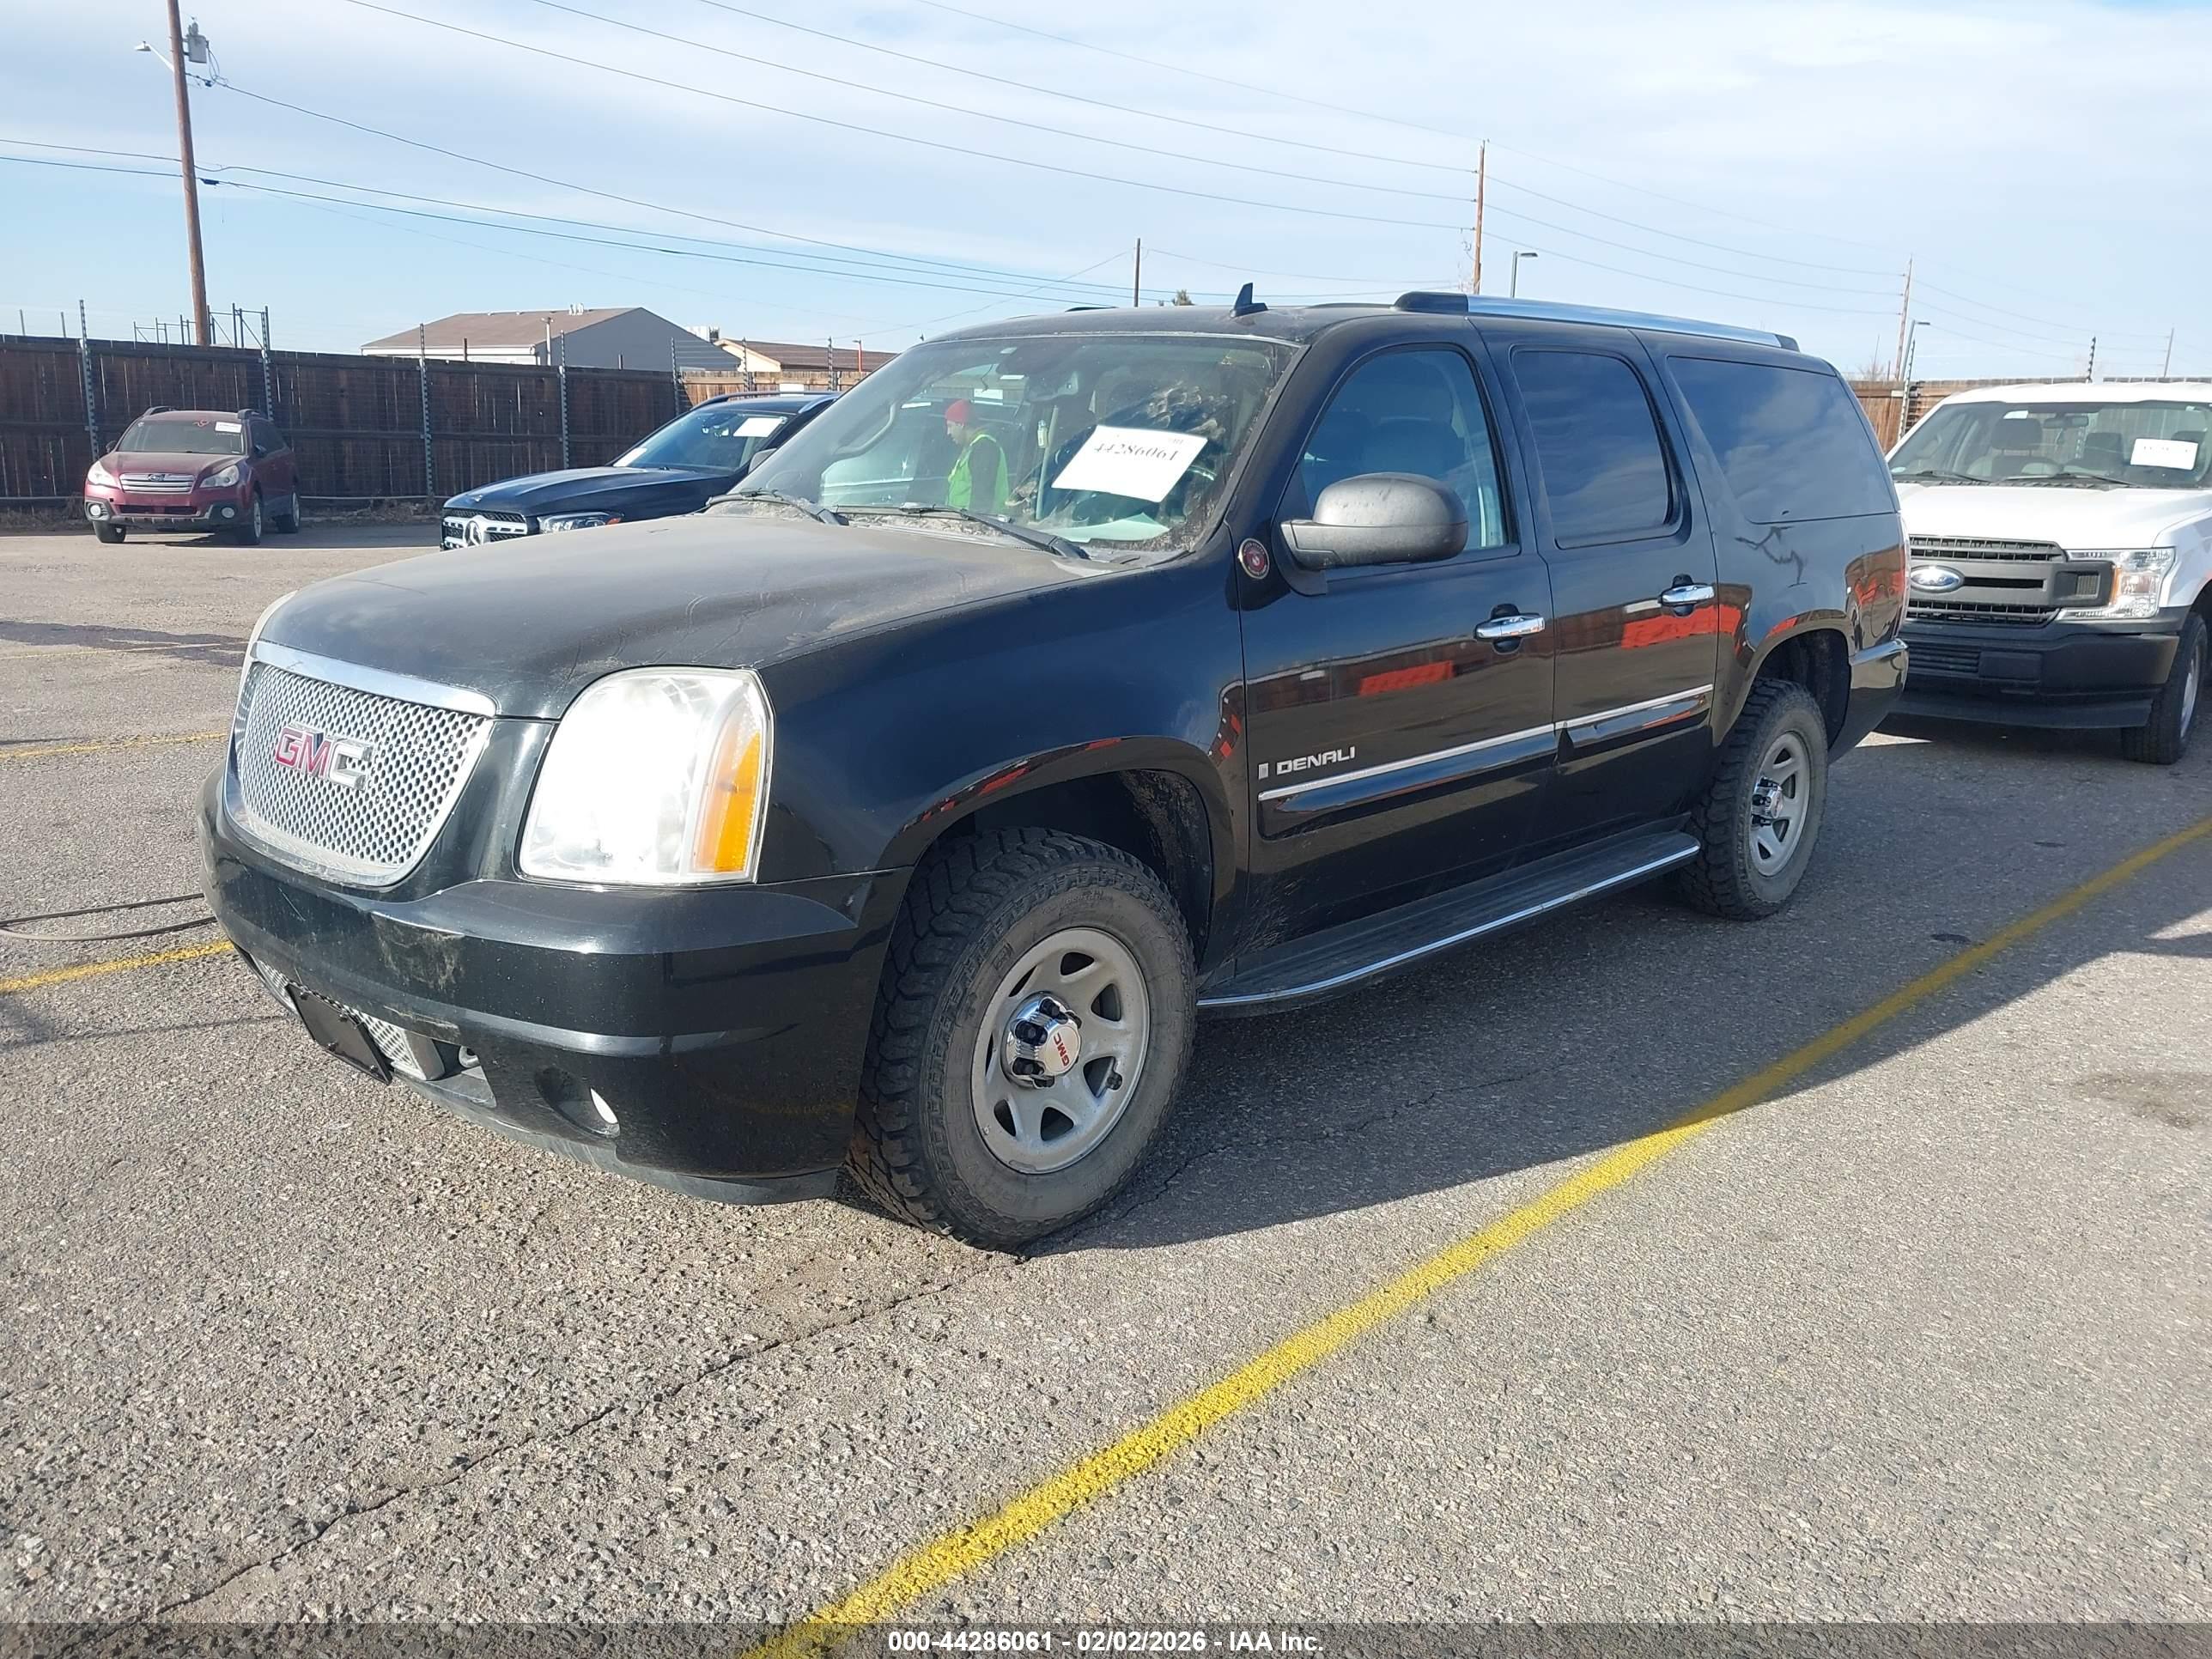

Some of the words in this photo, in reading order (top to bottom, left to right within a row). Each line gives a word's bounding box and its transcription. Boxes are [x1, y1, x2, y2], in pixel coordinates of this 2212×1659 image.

[275, 723, 373, 790] GMC
[1277, 746, 1355, 775] DENALI
[1054, 1032, 1070, 1066] GMC
